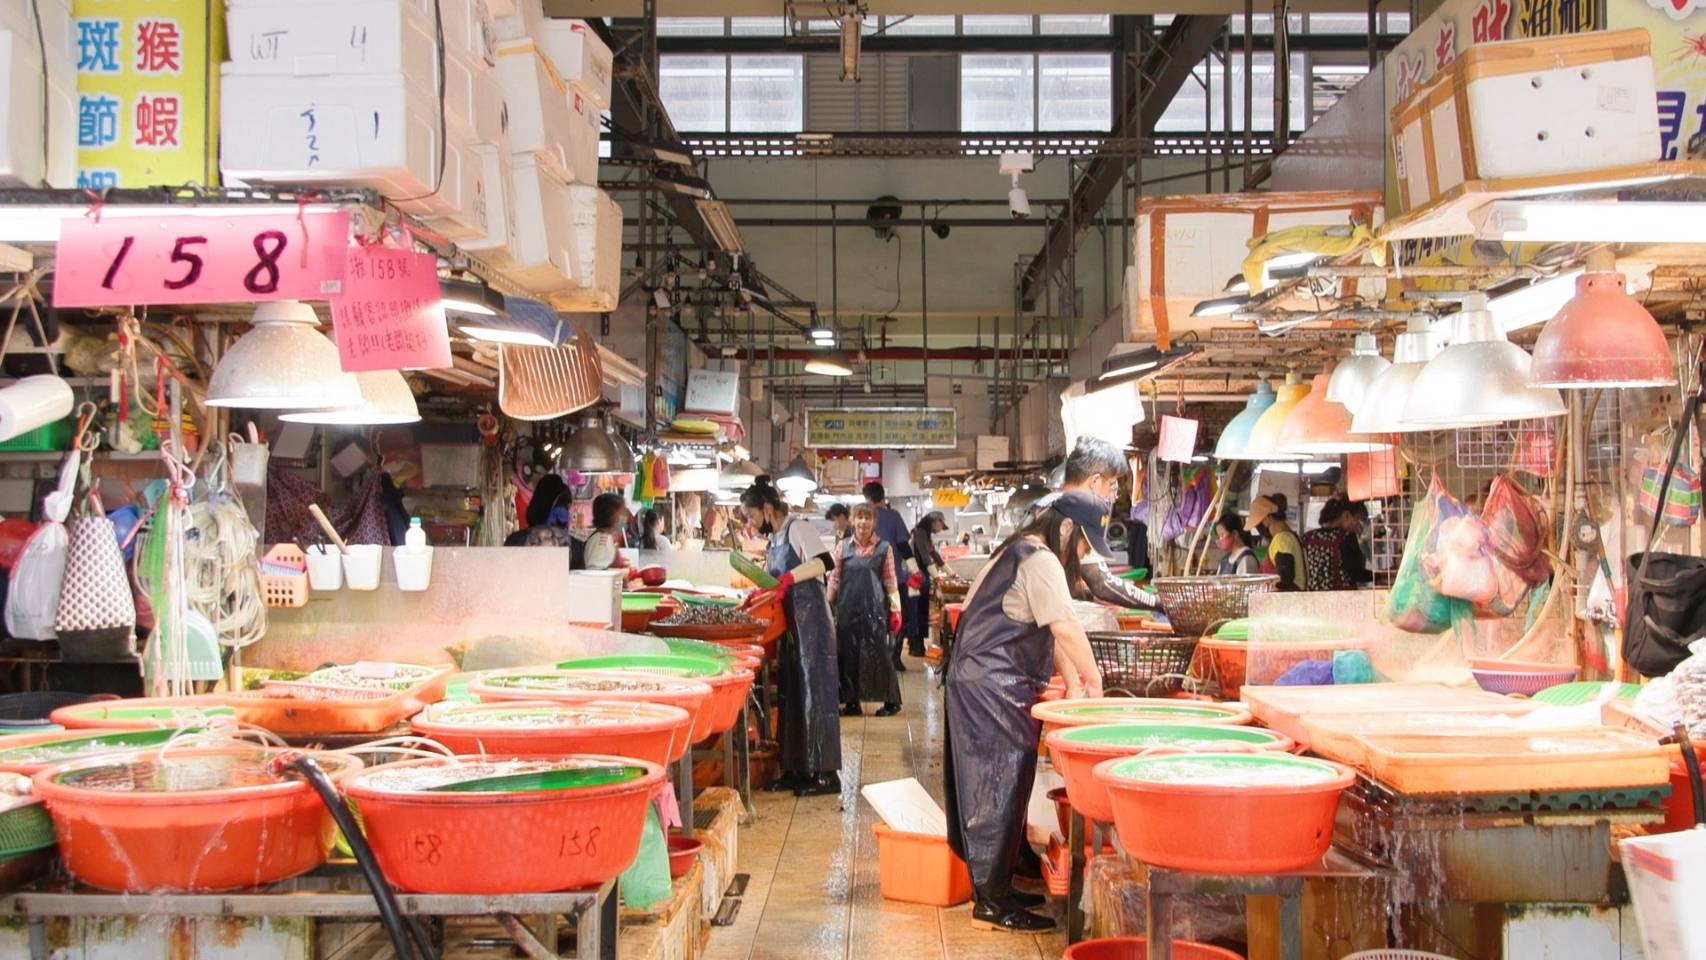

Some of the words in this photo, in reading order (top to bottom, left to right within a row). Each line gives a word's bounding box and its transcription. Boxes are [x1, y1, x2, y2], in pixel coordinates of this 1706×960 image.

[136, 21, 179, 146] 猴蝦
[101, 230, 288, 294] 158
[559, 826, 601, 857] 158
